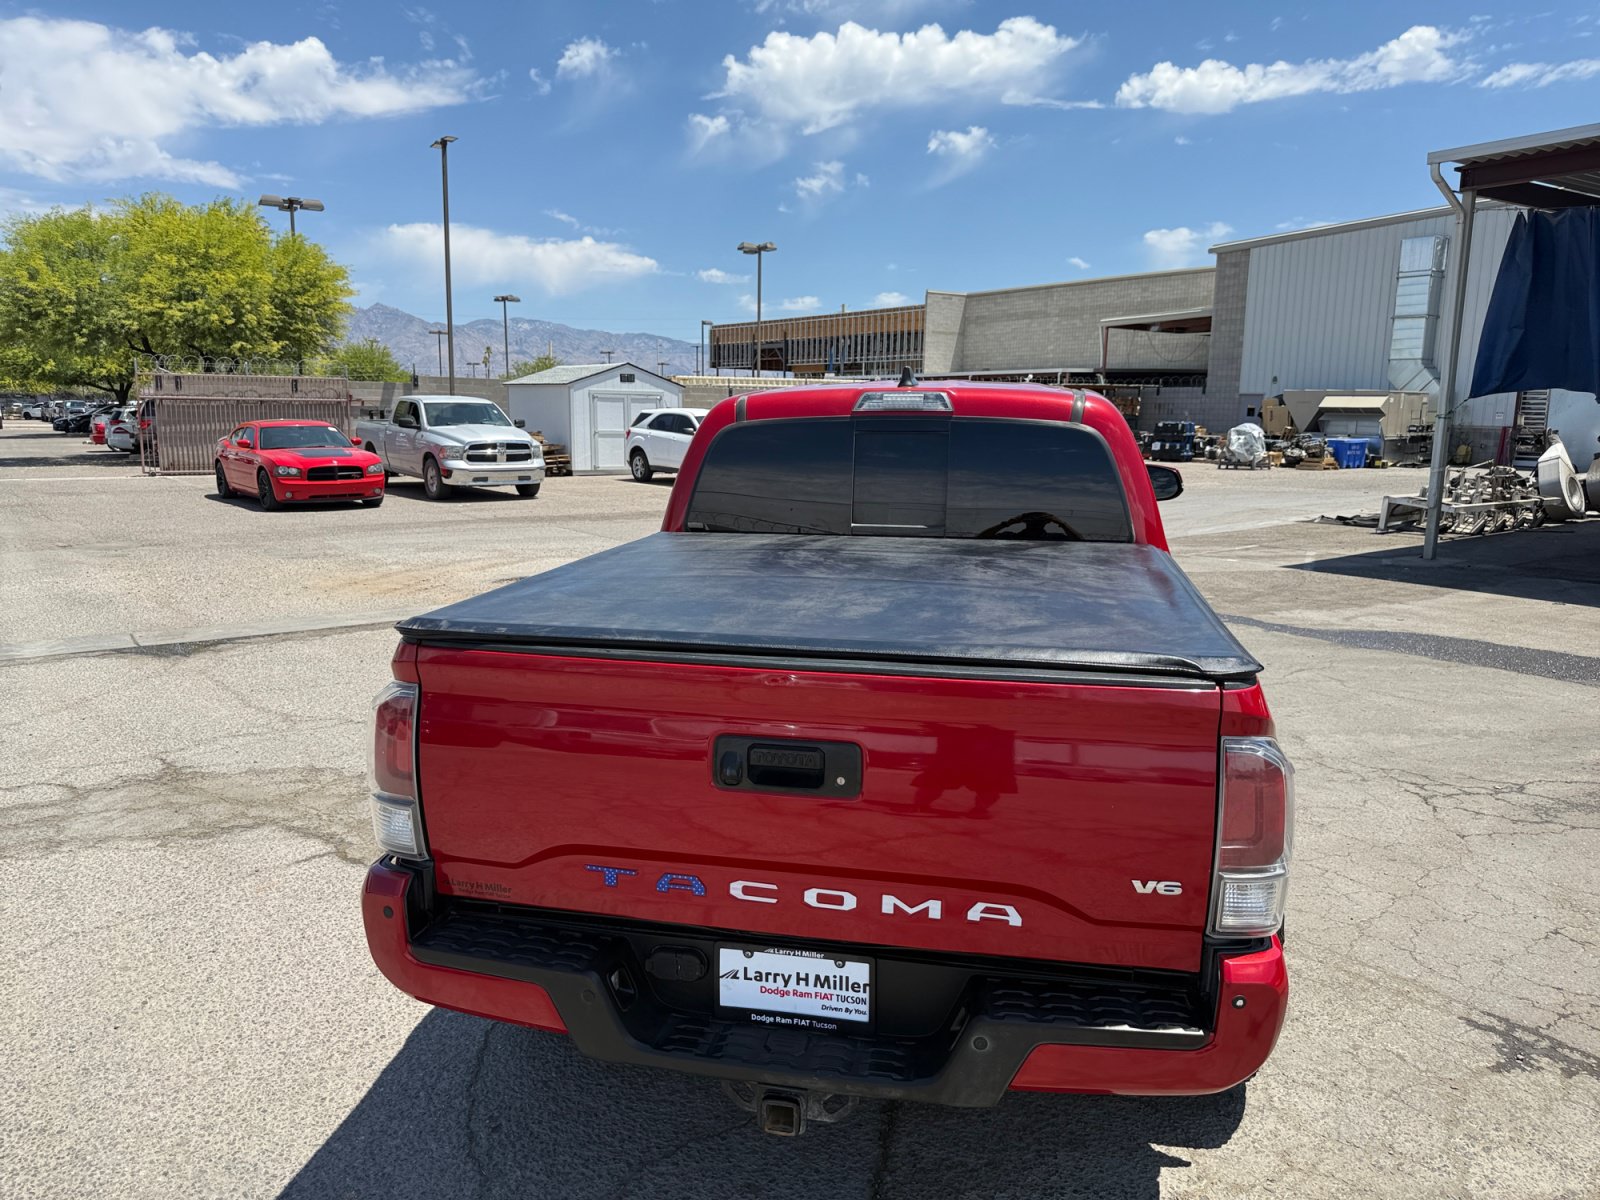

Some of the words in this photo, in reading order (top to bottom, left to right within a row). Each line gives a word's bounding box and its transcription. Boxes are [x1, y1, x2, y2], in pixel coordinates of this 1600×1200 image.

[584, 863, 1023, 927] TACOMA
[1131, 879, 1183, 896] V6
[774, 948, 796, 957] Larry
[802, 950, 825, 959] Miller
[743, 966, 793, 988] Larry
[796, 972, 810, 987] H
[813, 974, 870, 994] Miller
[760, 985, 791, 998] Dodge
[792, 987, 813, 999] Ram
[814, 990, 834, 1001] FIAT
[836, 994, 867, 1006] TUCSON
[821, 1004, 843, 1013] Driven
[844, 1006, 853, 1015] By
[751, 1013, 775, 1024] Dodge
[776, 1016, 793, 1025] Ram
[793, 1018, 810, 1026] FIAT
[812, 1020, 838, 1030] Tucson
